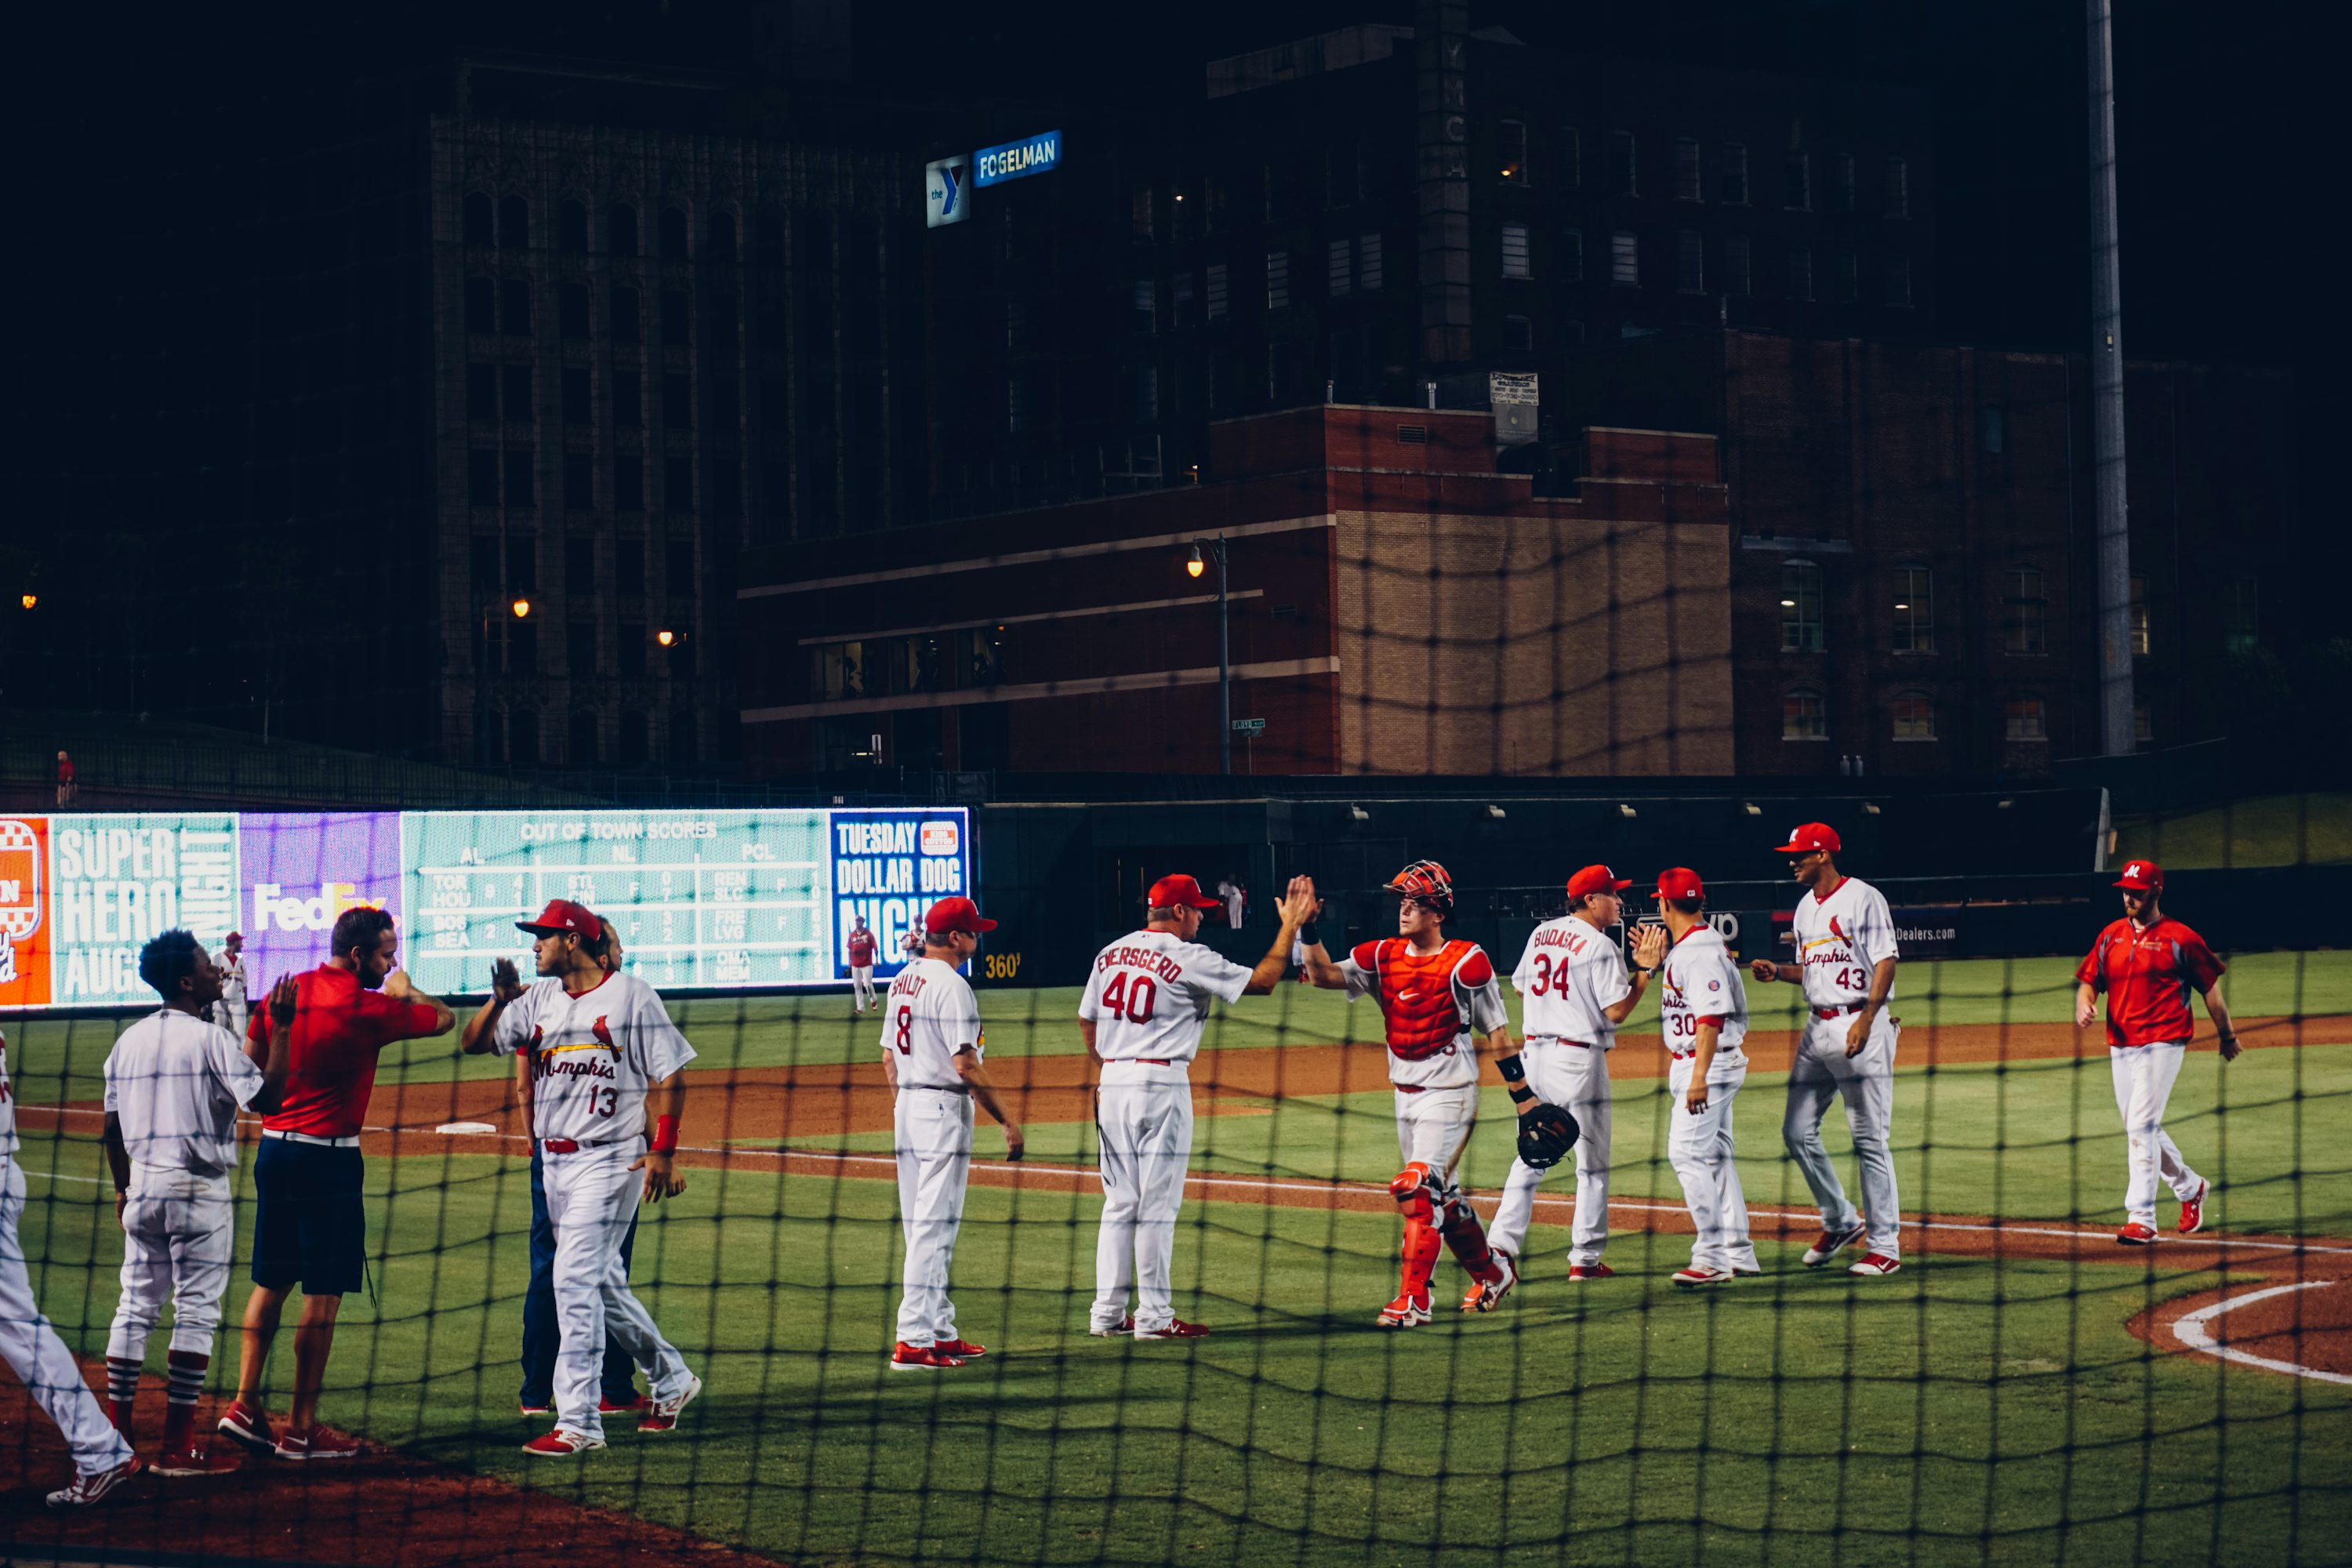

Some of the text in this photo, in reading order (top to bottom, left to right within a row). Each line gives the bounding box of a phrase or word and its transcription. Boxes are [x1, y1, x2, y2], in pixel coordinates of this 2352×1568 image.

[980, 140, 1055, 179] FOGELMAN
[931, 189, 943, 200] the
[521, 822, 717, 840] OUT OF TOWN SCORES
[837, 822, 916, 855] TUESDAY
[59, 828, 175, 879] SUPER
[460, 847, 485, 864] AL
[612, 845, 636, 862] NL
[742, 844, 775, 861] PCL
[714, 872, 746, 887] REN
[837, 858, 961, 894] DOLLAR DOG
[2124, 864, 2140, 878] M
[180, 827, 232, 939] NIGHT
[433, 875, 466, 891] TOR
[568, 875, 595, 890] STL
[433, 892, 470, 907] HOU
[714, 887, 743, 901] SLC
[62, 880, 177, 942] HERO
[715, 910, 746, 924] FRE
[485, 924, 495, 939] 2
[630, 922, 641, 936] F
[778, 916, 787, 931] F
[435, 932, 470, 948] SEA
[1534, 928, 1587, 956] BUDASKA
[1531, 953, 1569, 1000] 34
[1835, 967, 1867, 990] 43
[1102, 971, 1156, 1025] 40
[897, 1004, 912, 1055] 8
[1671, 1013, 1697, 1036] 30
[589, 1084, 619, 1118] 13
